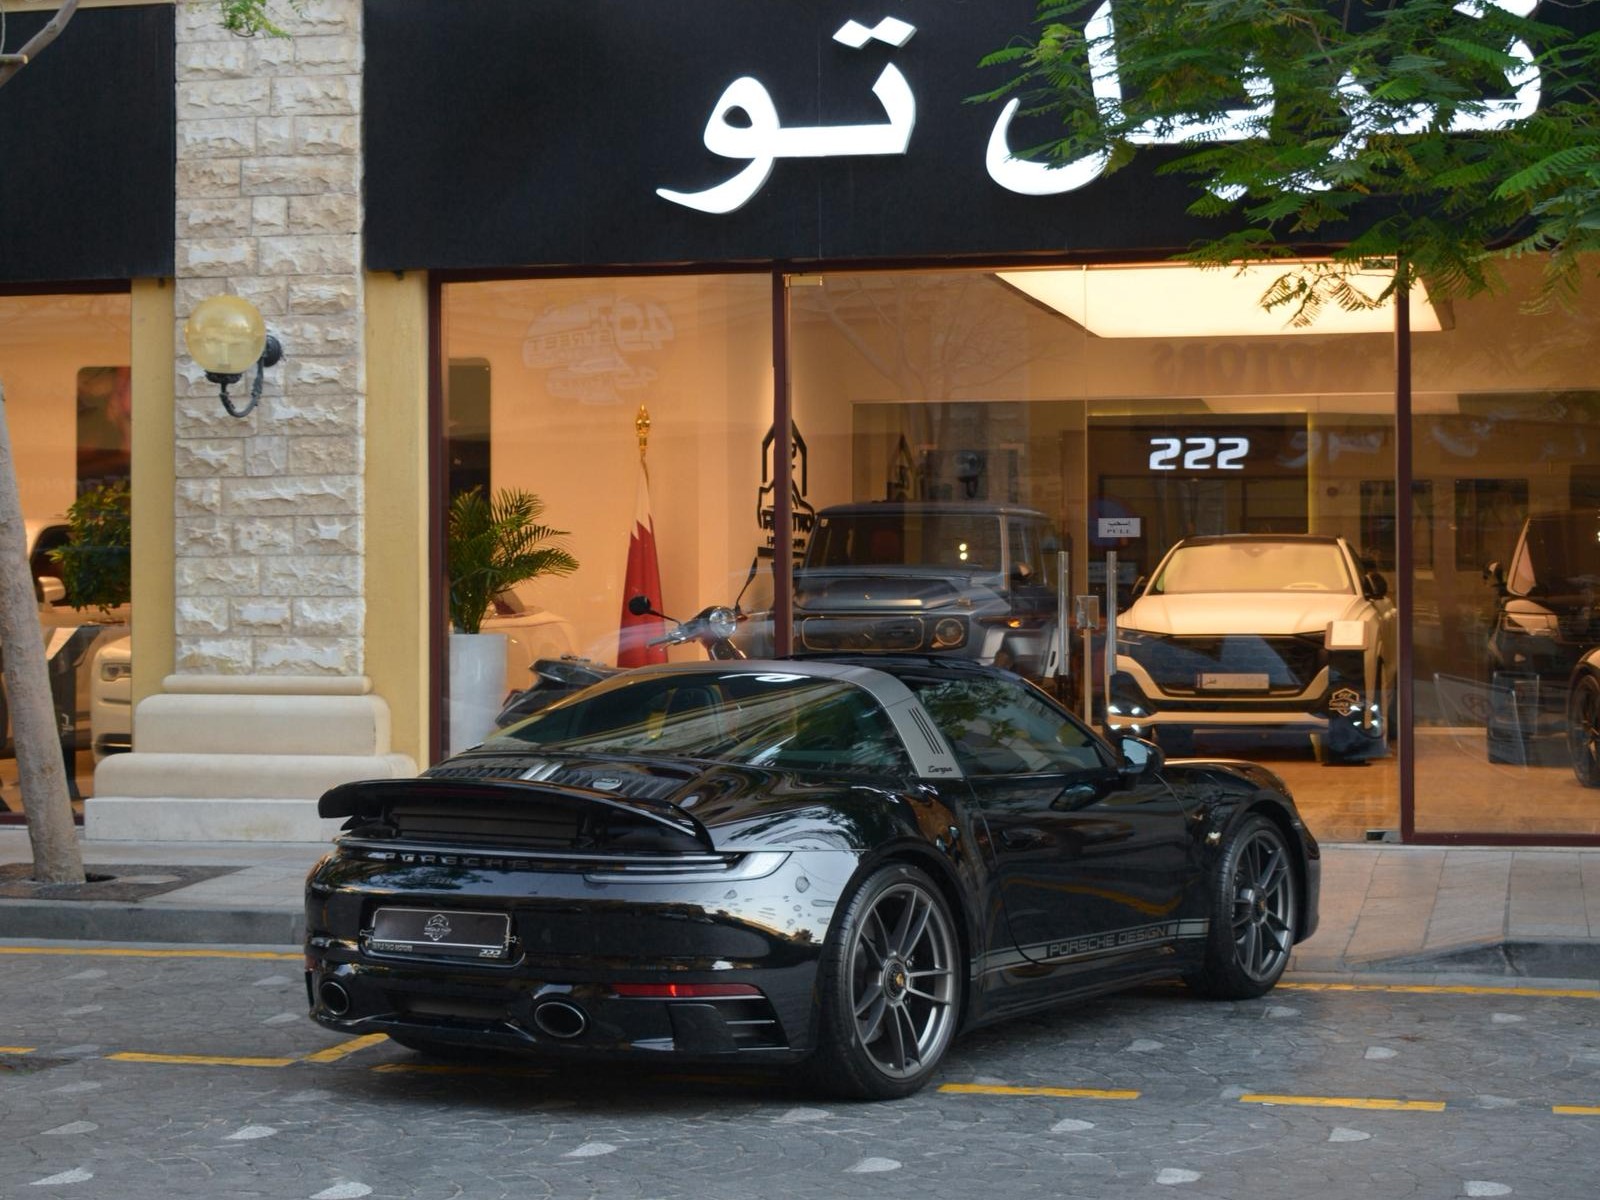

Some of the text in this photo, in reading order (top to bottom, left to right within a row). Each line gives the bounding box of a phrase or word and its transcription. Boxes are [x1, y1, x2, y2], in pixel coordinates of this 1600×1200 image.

[656, 16, 918, 214] تو
[1149, 437, 1250, 471] 222
[928, 765, 953, 775] Targa
[1048, 927, 1167, 957] PORSCHE DESIGN
